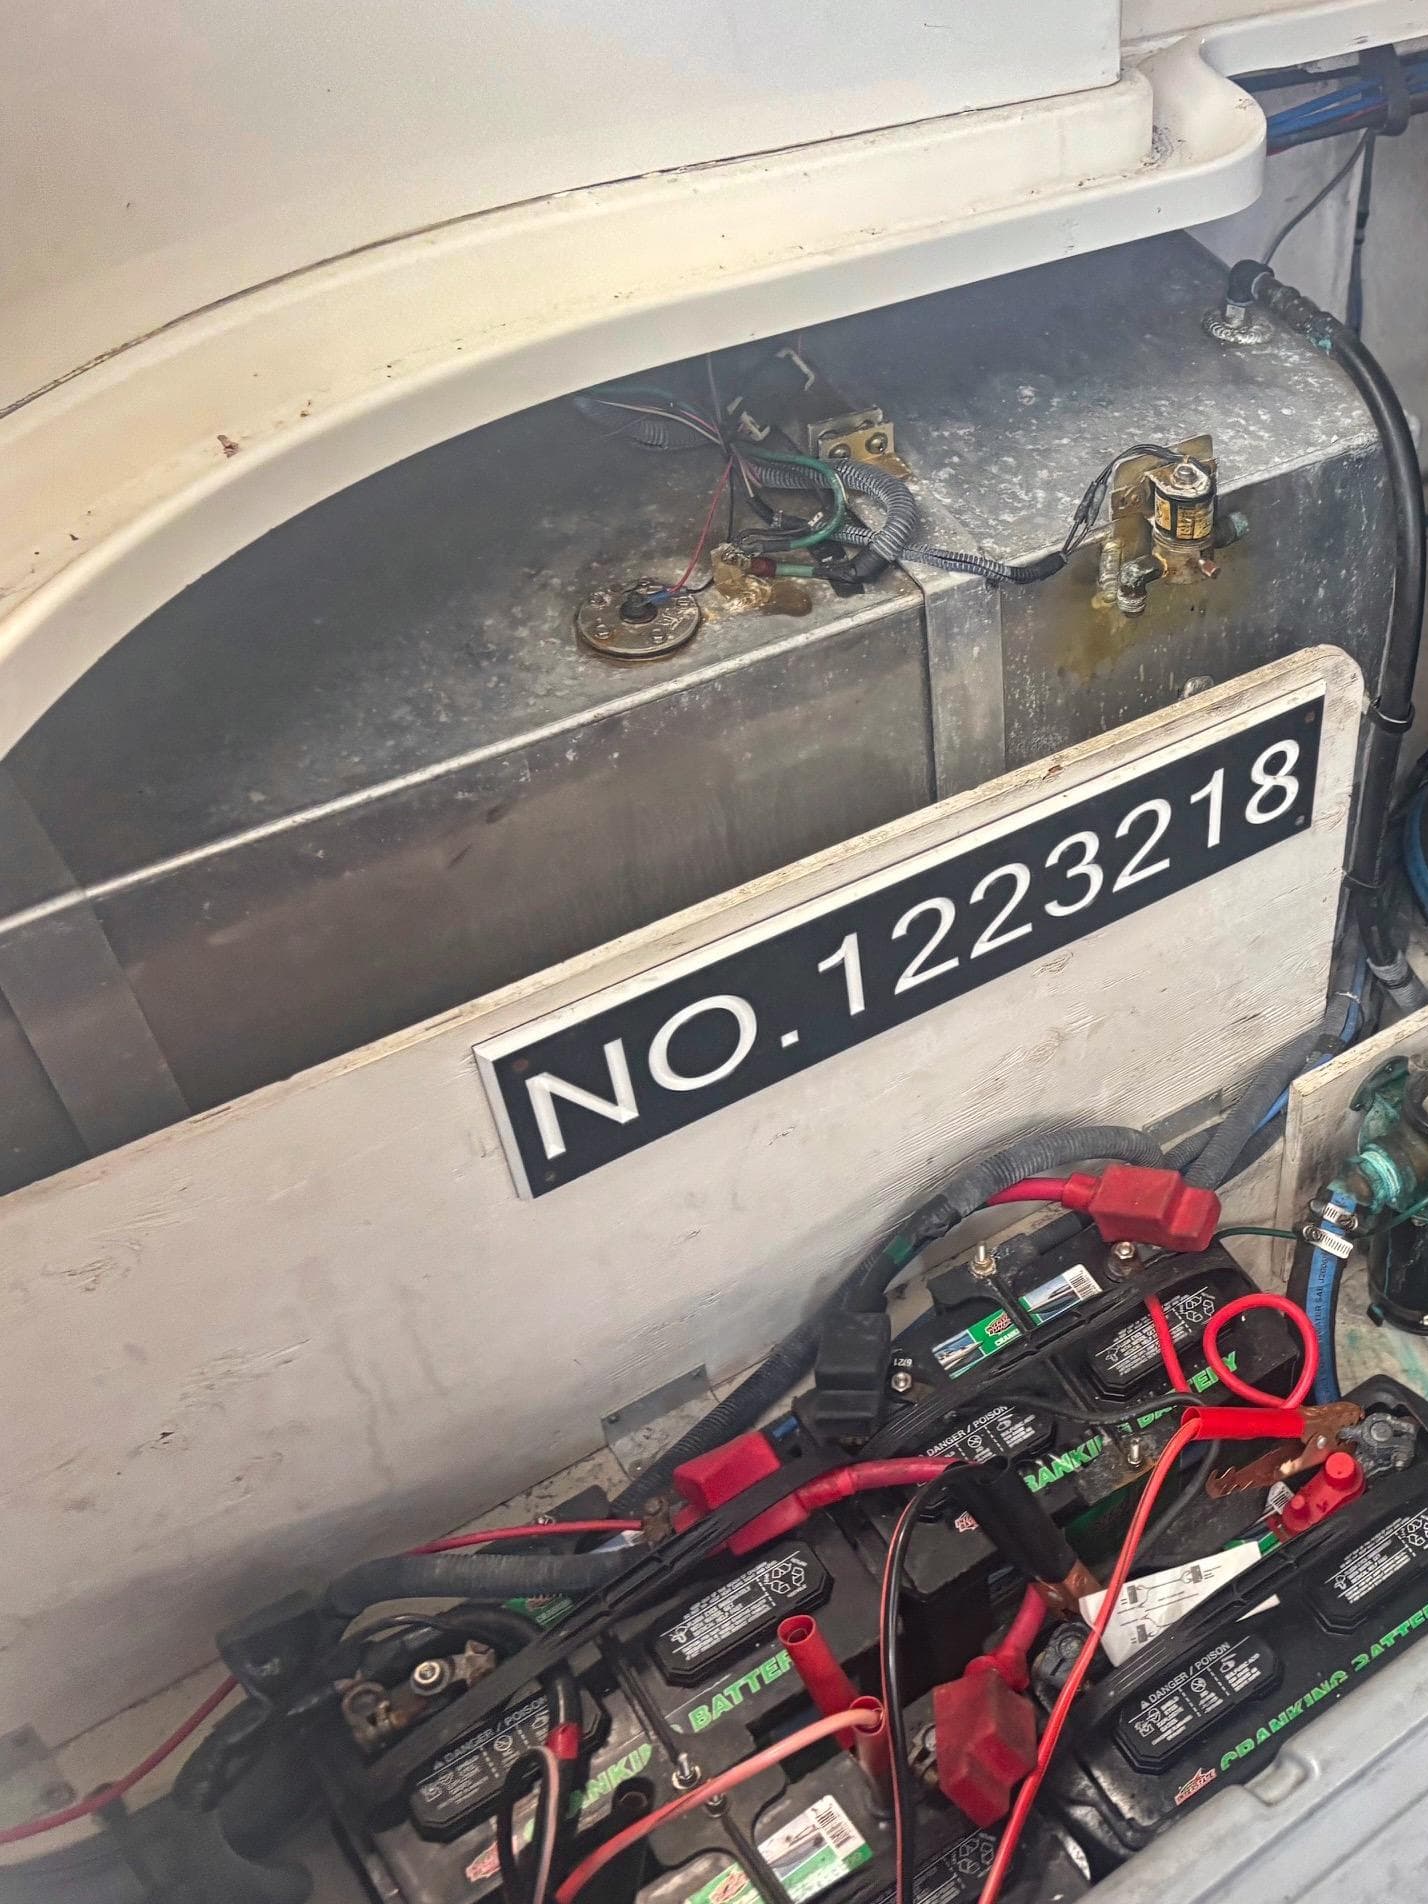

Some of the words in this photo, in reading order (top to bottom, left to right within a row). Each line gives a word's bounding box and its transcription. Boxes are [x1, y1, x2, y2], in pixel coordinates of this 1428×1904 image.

[926, 1426, 967, 1457] DANGER
[972, 1406, 1008, 1428] POISON
[1149, 1674, 1190, 1703] DANGER
[1194, 1641, 1231, 1671] POISON
[444, 1728, 494, 1767] DANGER
